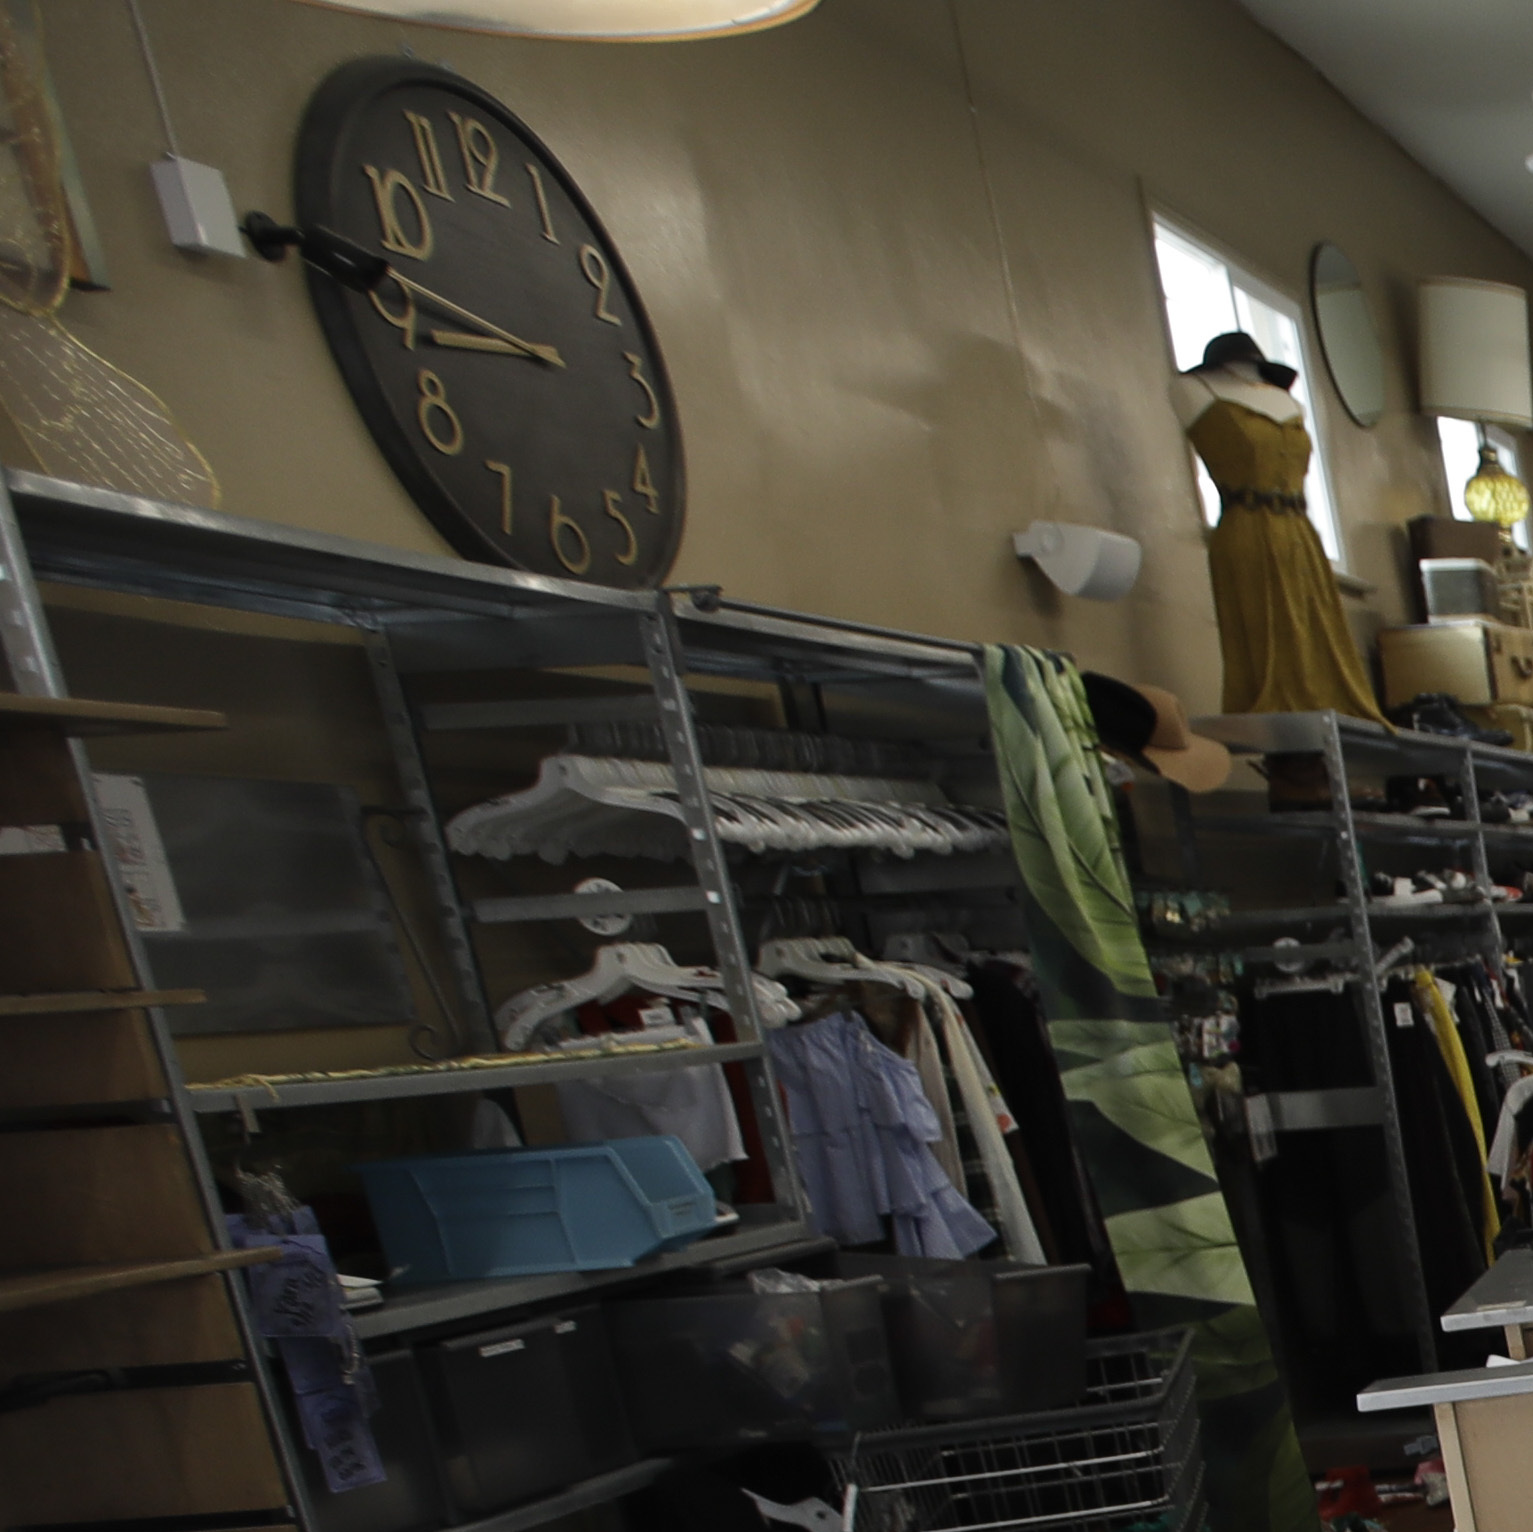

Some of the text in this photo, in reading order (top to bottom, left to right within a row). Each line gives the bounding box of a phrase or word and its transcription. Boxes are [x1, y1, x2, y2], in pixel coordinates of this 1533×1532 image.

[403, 109, 456, 203] 11
[446, 110, 511, 208] 12
[362, 163, 433, 261] 10
[525, 161, 560, 246] 1
[366, 272, 417, 352] 9
[578, 244, 622, 327] 2
[417, 366, 464, 456] 8
[624, 351, 660, 429] 3
[484, 459, 512, 535] 7
[632, 442, 660, 515] 4
[549, 494, 591, 575] 6
[602, 488, 637, 566] 5
